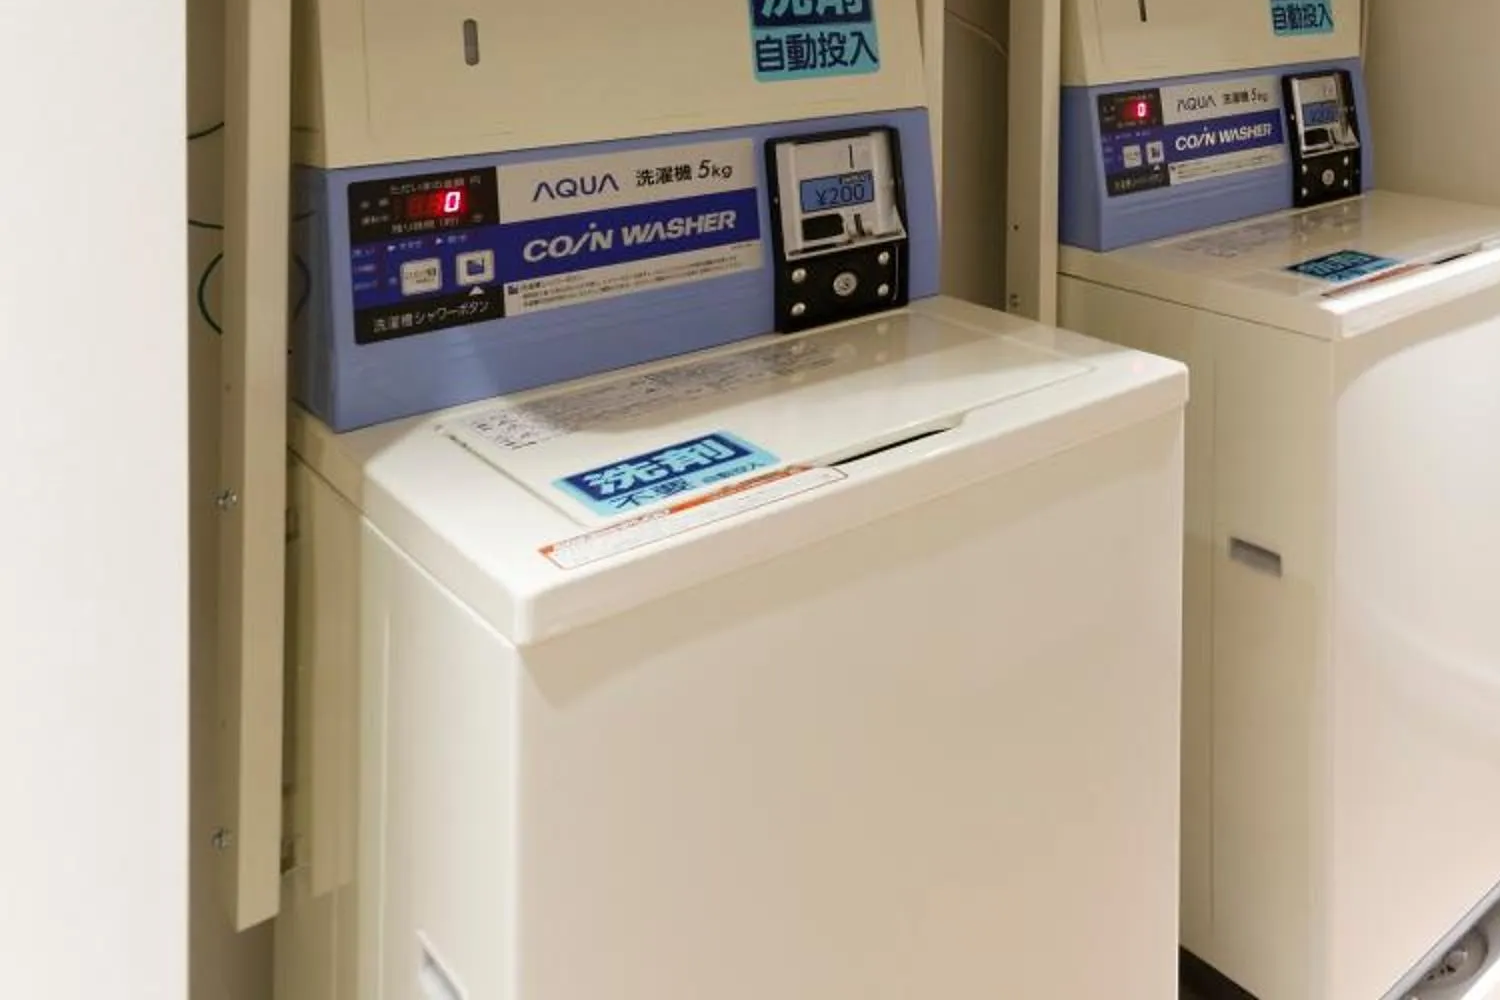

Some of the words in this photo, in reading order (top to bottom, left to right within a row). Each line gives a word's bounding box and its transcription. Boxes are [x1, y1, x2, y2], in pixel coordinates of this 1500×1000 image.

[1271, 2, 1335, 31] 自動投入
[755, 31, 879, 73] 自動投入
[1136, 101, 1148, 118] 0
[1176, 92, 1217, 113] AQUA
[1174, 125, 1217, 152] COIN
[1218, 122, 1273, 144] WASHER
[532, 172, 620, 203] AQUA
[635, 163, 693, 188] 洗濯機
[697, 159, 734, 182] 5kg
[815, 183, 865, 206] ¥200
[443, 190, 461, 214] 0
[522, 221, 612, 264] COIN
[621, 208, 738, 249] WASHER
[582, 439, 738, 496] 洗剤
[603, 477, 692, 510] 不要
